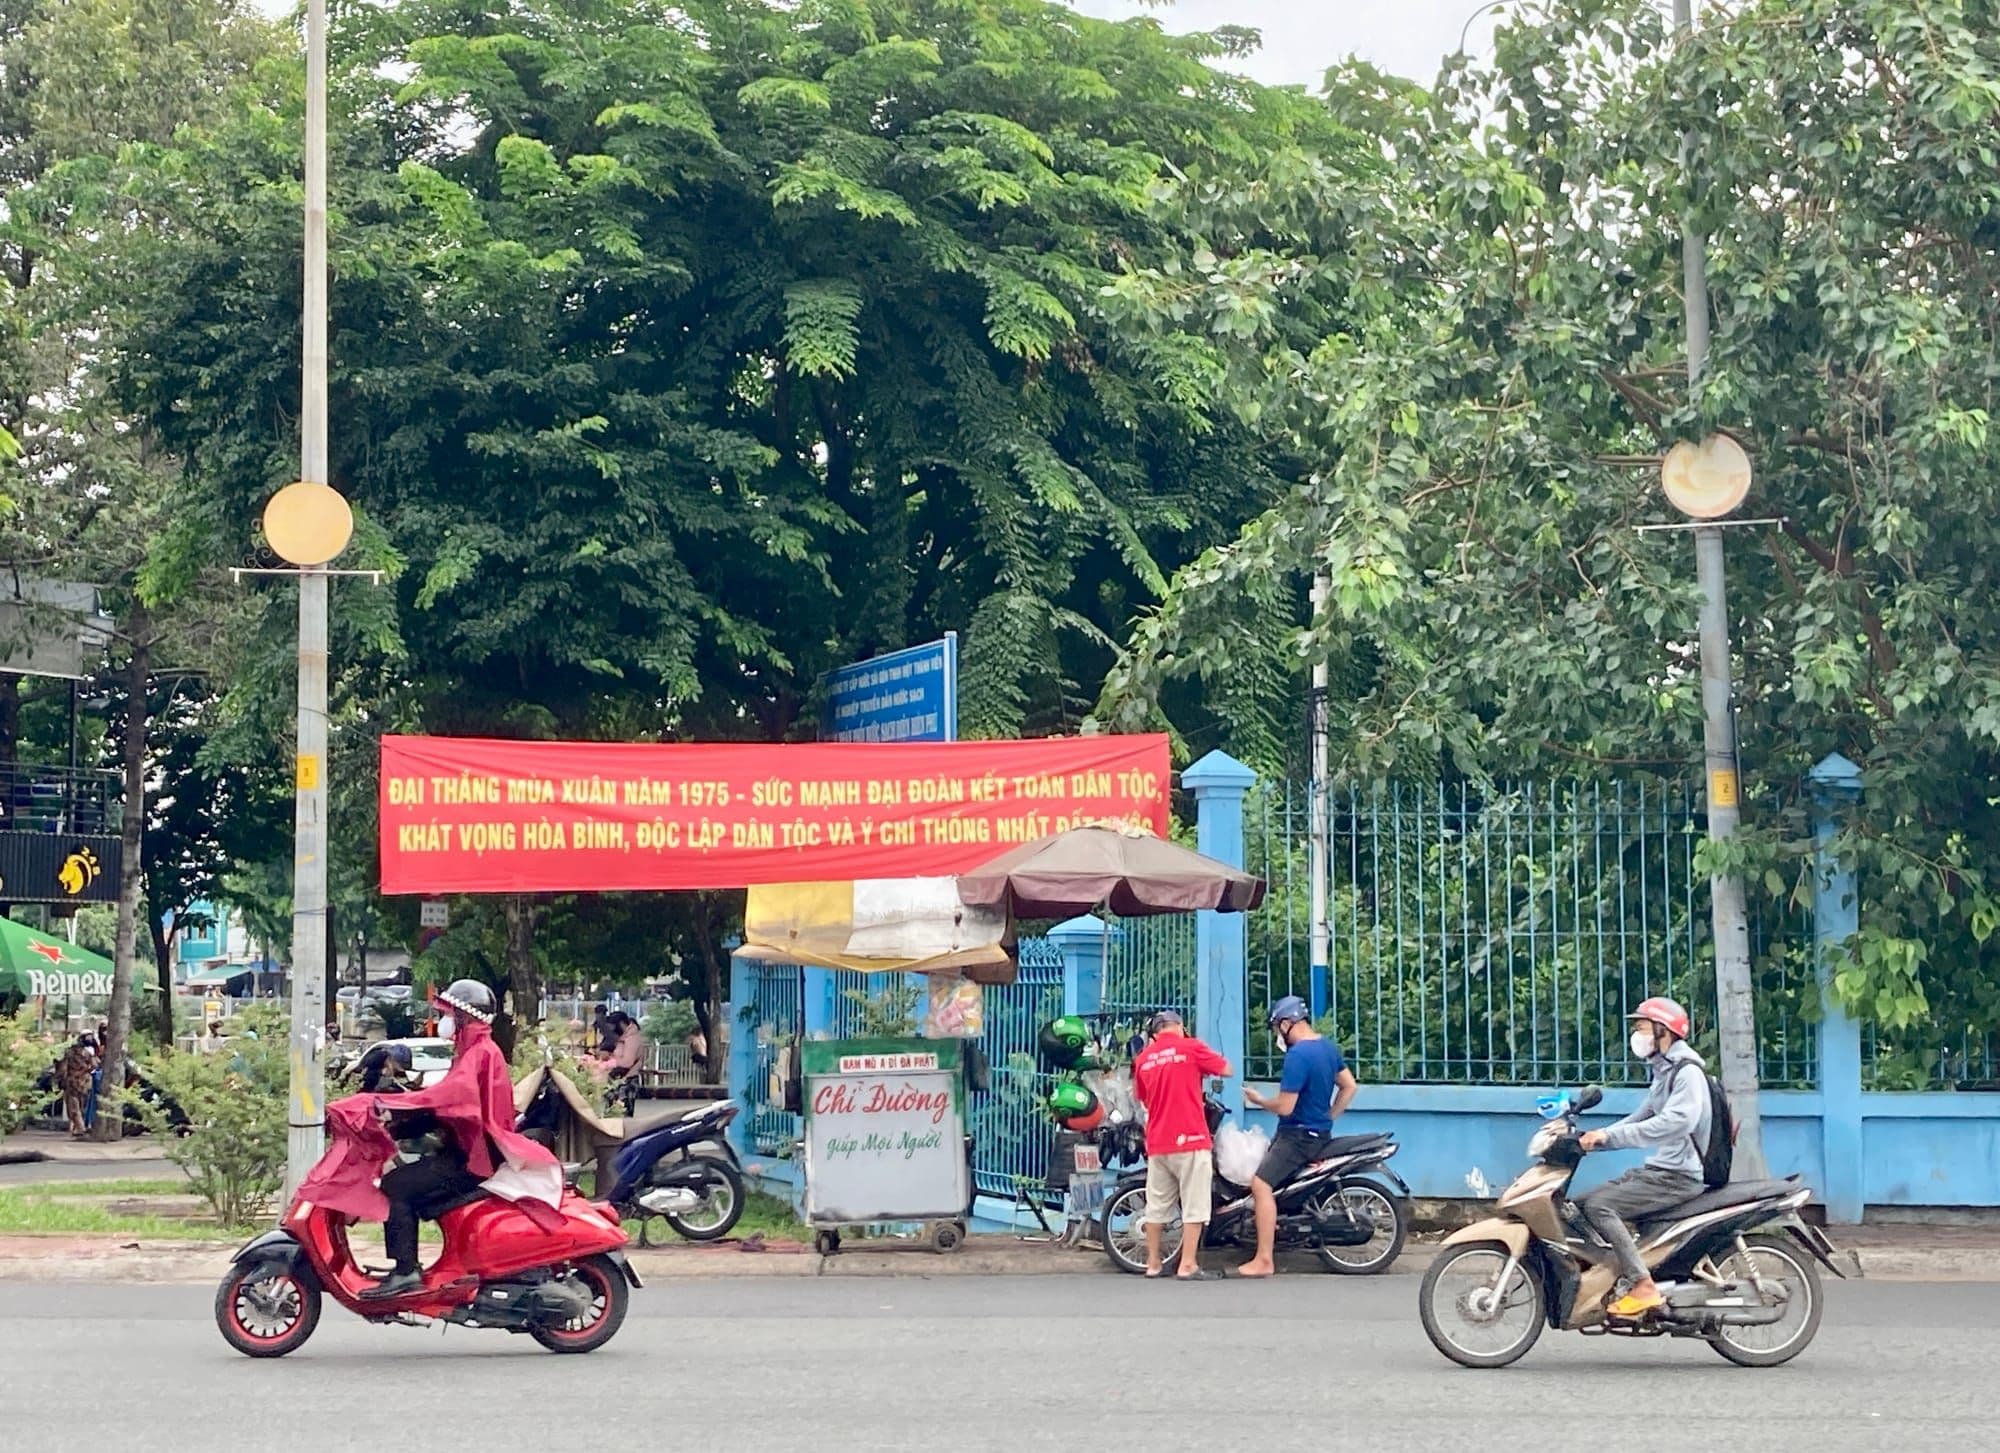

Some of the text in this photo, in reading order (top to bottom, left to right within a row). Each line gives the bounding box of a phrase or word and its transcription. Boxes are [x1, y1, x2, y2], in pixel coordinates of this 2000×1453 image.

[388, 777, 424, 811] ĐẠI
[431, 769, 500, 805] THẮNG
[507, 773, 555, 804] MÙA
[561, 774, 617, 805] XUÂN
[624, 776, 670, 806] NĂM
[678, 781, 729, 807] 1975
[752, 775, 792, 807] SỨC
[800, 780, 860, 814] MẠNH
[867, 780, 901, 810] ĐẠI
[907, 774, 963, 803] ĐOÀN
[971, 767, 1006, 801] KẾT
[1012, 771, 1065, 800] TOÀN
[1072, 769, 1111, 799] DÂN
[1117, 767, 1162, 804] TỘC,
[399, 817, 453, 852] KHÁT
[458, 822, 516, 857] VỌNG
[523, 815, 566, 850] HÒA
[573, 816, 630, 853] BÌNH,
[636, 816, 680, 855] ĐỘC
[687, 818, 726, 855] LẬP
[733, 818, 773, 849] DÂN
[780, 816, 821, 853] TỘC
[828, 817, 855, 846] VÀ
[861, 818, 874, 846] Ý
[880, 816, 915, 844] CHÍ
[923, 810, 990, 844] THỐNG
[997, 808, 1050, 843] NHẤT
[26, 968, 115, 996] Heineke
[880, 1058, 886, 1069] A
[863, 1081, 950, 1124] Đường
[862, 1131, 892, 1157] Mọi
[896, 1129, 943, 1160] Người
